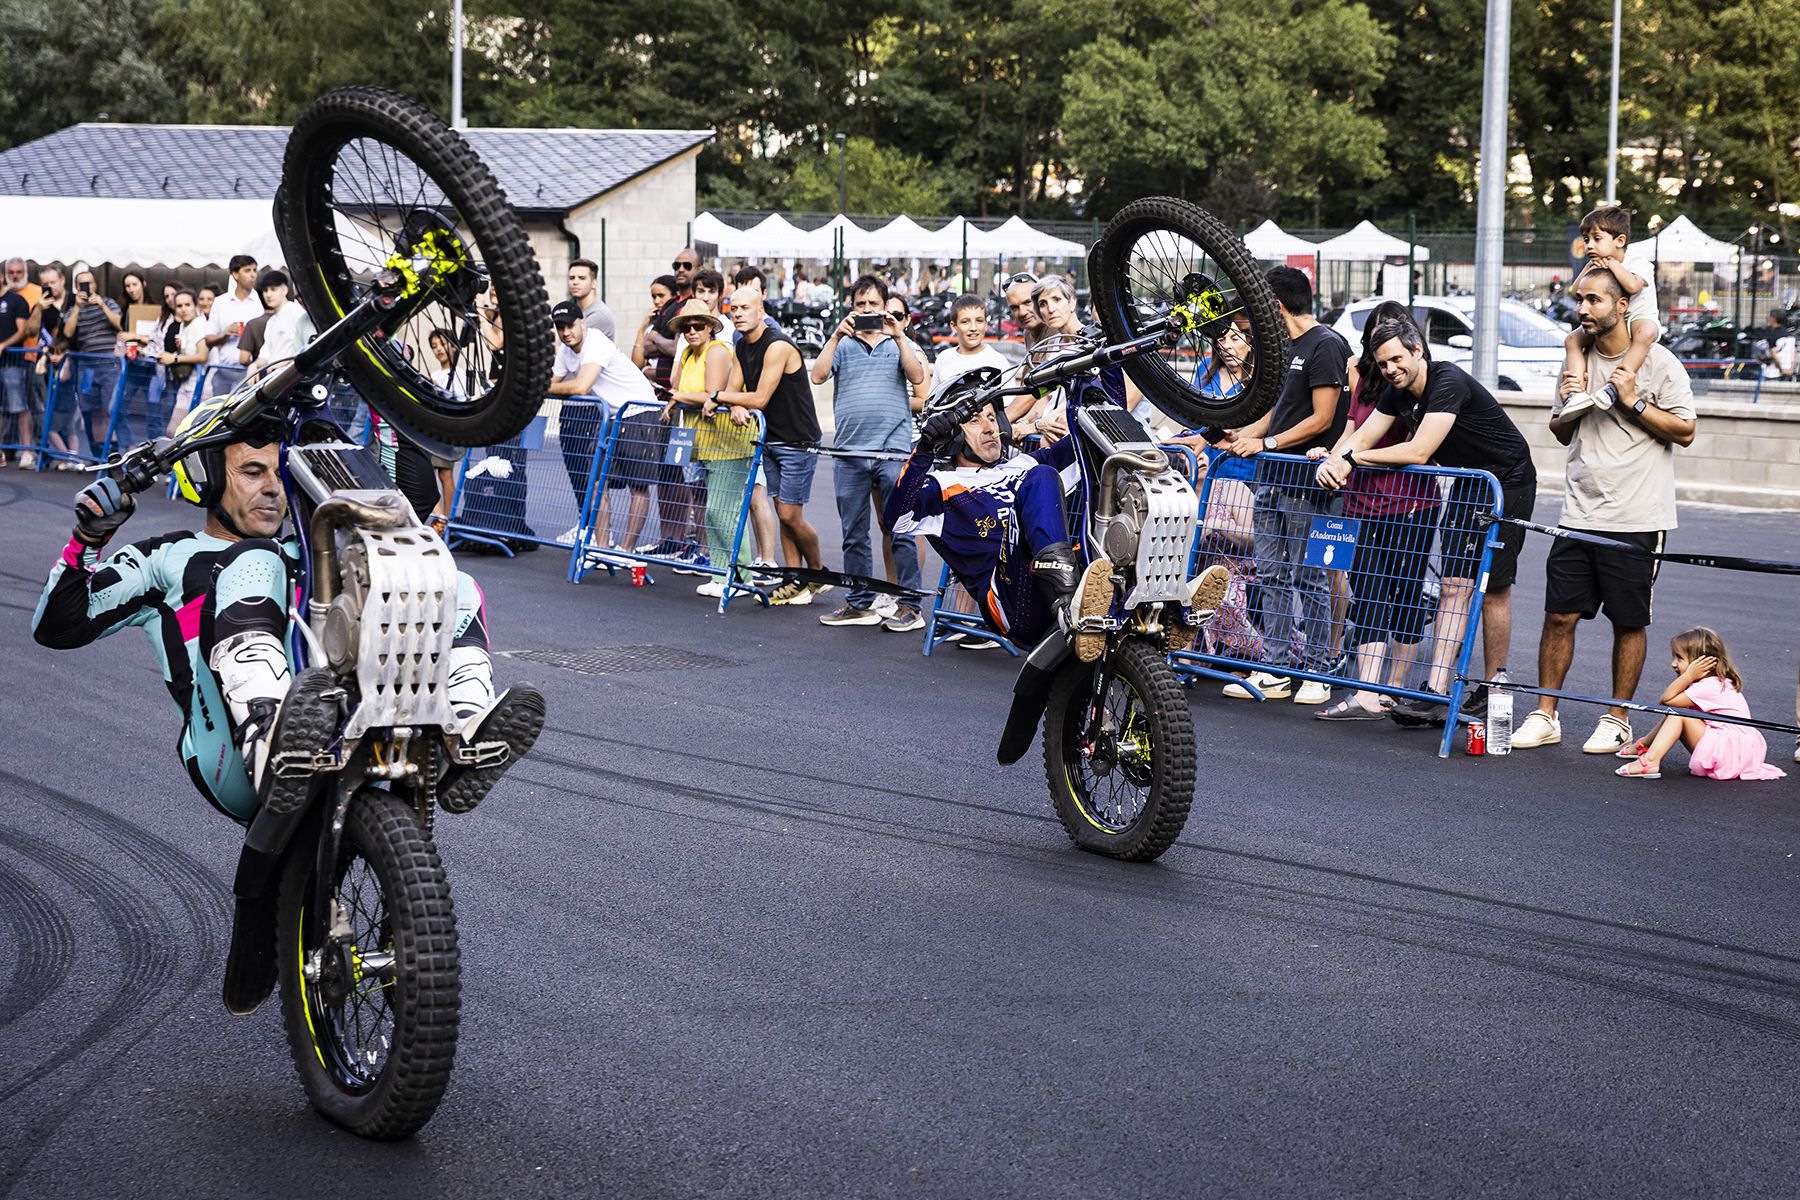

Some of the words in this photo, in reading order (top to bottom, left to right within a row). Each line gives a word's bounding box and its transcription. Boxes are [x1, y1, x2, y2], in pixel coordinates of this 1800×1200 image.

[1326, 520, 1344, 530] Comú
[1310, 530, 1337, 541] d'Andorra
[1342, 533, 1355, 543] Vella
[1034, 560, 1074, 572] hebo
